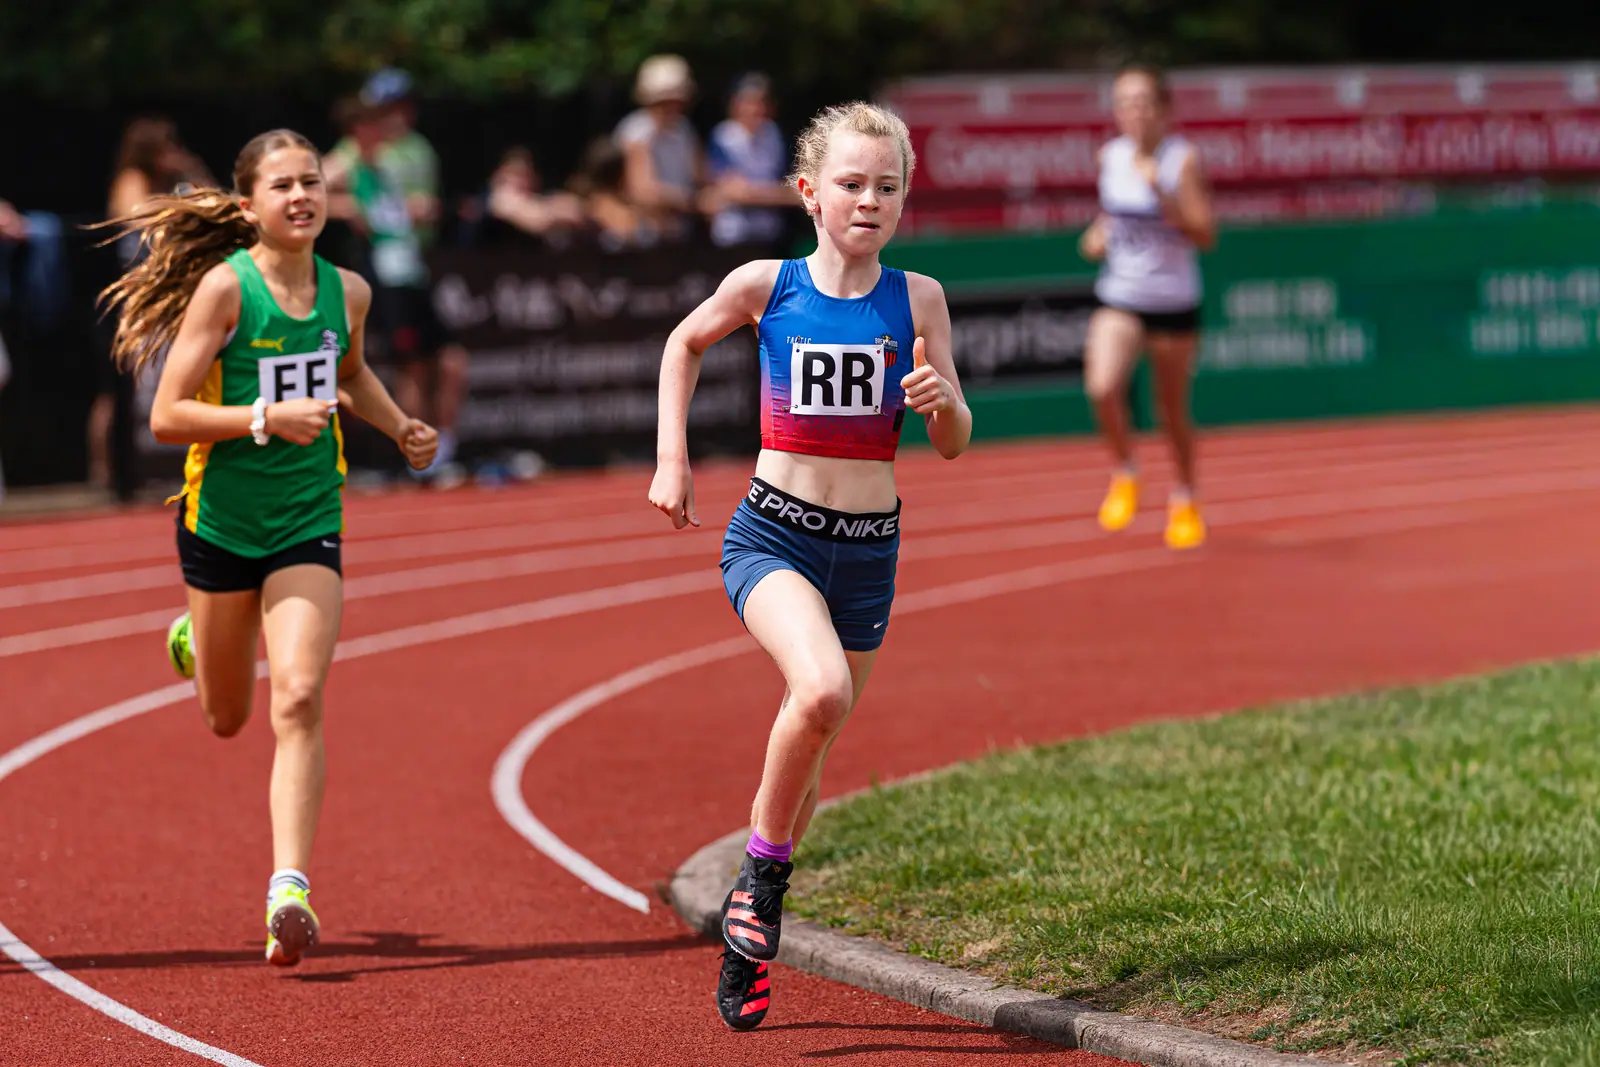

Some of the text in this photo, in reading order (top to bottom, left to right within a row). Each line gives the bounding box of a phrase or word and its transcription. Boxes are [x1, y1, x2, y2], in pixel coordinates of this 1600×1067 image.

[801, 351, 875, 407] RR
[759, 492, 827, 531] PRO
[832, 515, 899, 538] NIKE
